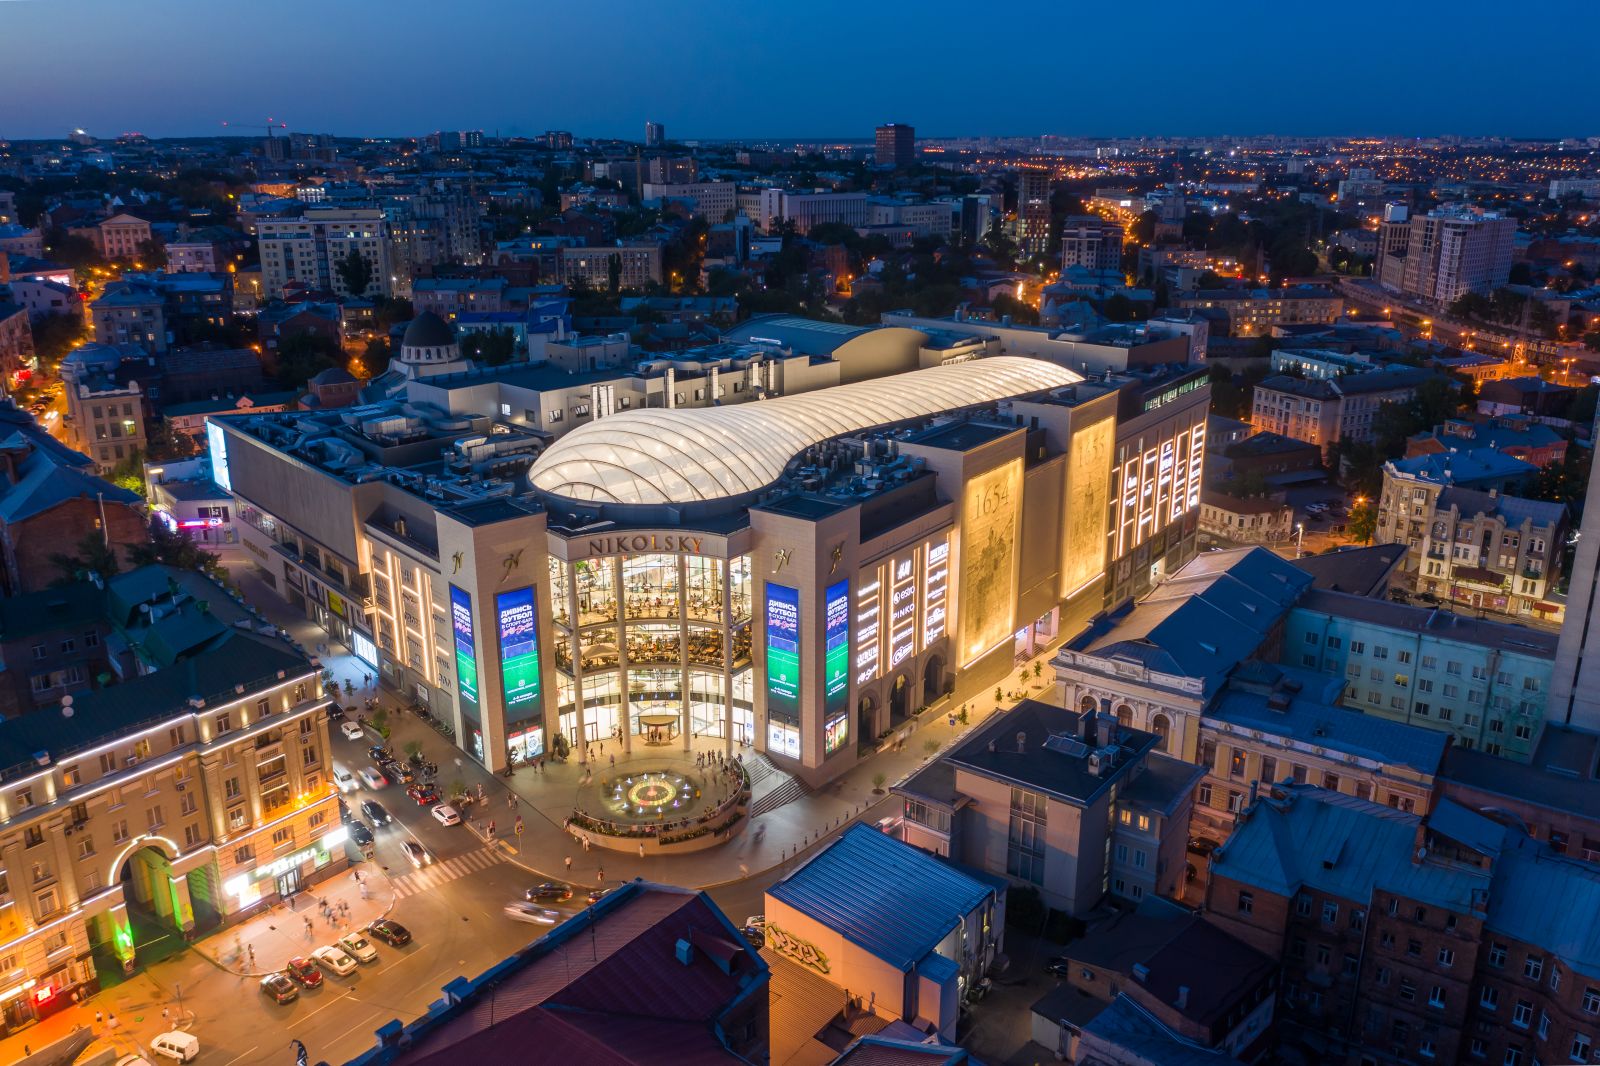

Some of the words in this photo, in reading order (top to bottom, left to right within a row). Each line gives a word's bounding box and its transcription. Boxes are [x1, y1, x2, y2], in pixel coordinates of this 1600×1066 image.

[975, 476, 1010, 519] 1654
[589, 534, 703, 556] NIKOLSKY
[501, 604, 532, 618] ДИВИСЬ
[769, 600, 797, 611] ДИВИСЬ
[769, 607, 797, 618] ФУТБОЛ
[892, 603, 915, 621] PINKO
[501, 611, 533, 624] ФУТБОЛ
